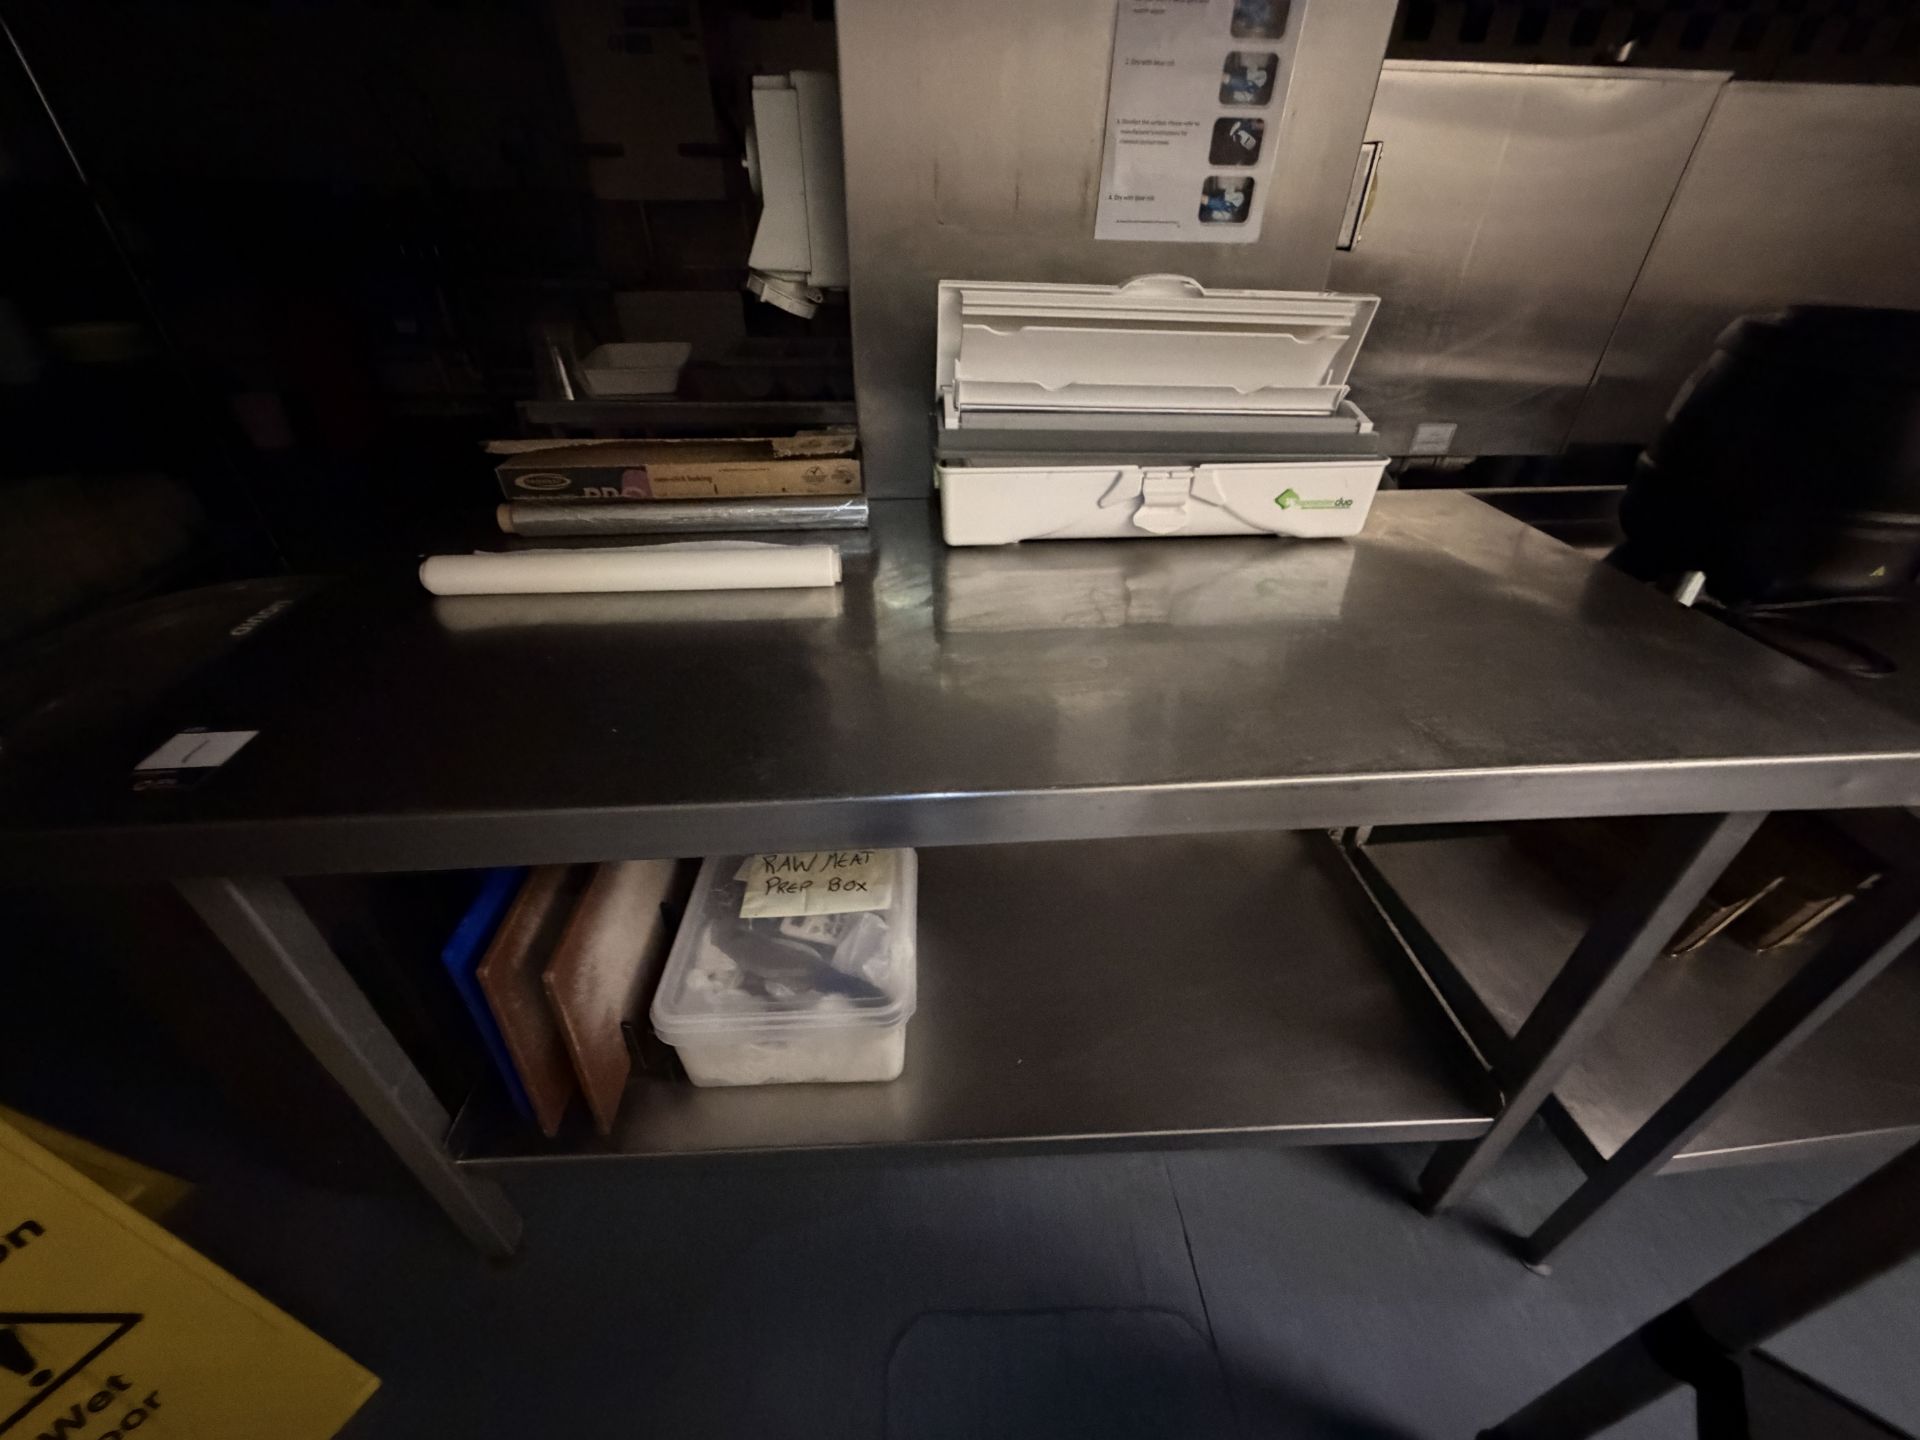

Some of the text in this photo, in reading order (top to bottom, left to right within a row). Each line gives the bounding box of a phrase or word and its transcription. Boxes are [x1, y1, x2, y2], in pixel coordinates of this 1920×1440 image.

[762, 851, 875, 875] RAW MEAT
[765, 876, 814, 895] PREP
[36, 1374, 133, 1440] Wet
